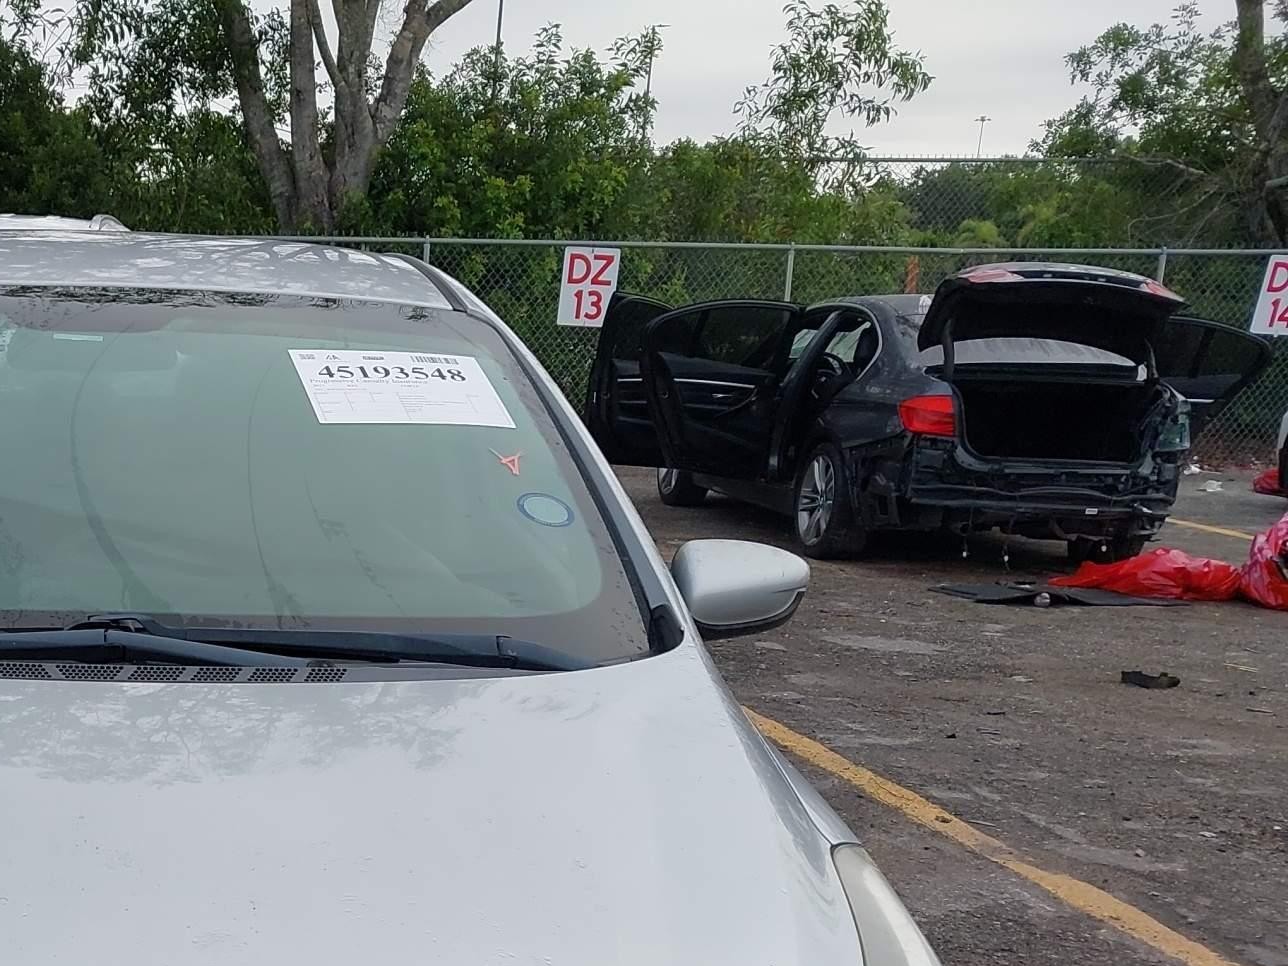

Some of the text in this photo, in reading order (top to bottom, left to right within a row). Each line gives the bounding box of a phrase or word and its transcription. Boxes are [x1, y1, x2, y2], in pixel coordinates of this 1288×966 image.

[567, 253, 615, 286] DZ
[574, 289, 602, 320] 13
[318, 365, 466, 382] 45193548
